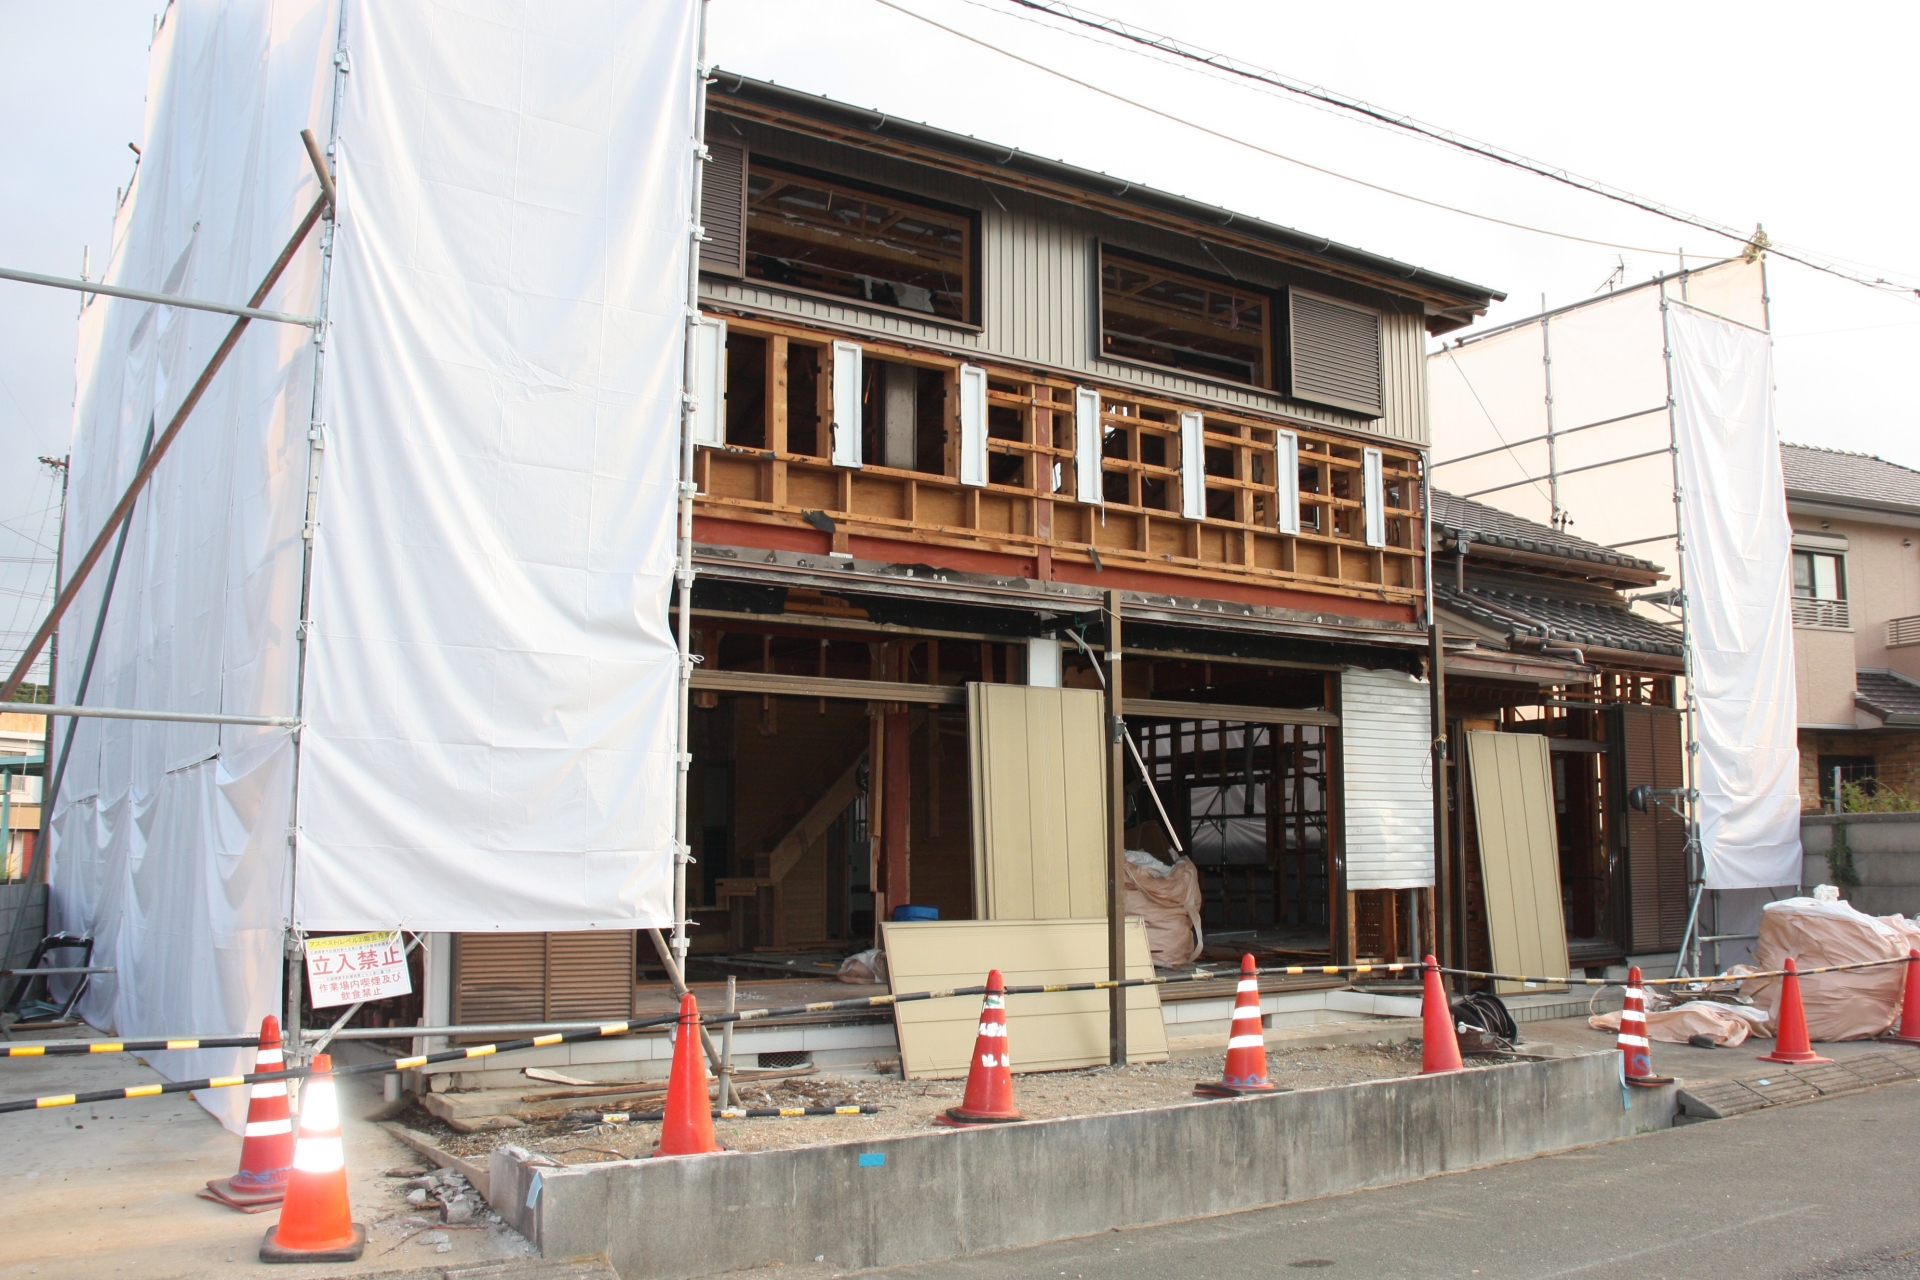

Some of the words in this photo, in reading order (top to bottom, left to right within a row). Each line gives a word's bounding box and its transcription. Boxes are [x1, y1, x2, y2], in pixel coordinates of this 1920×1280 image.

[312, 946, 403, 976] 立入禁止
[319, 972, 401, 993] 作業場内喫煙及び
[341, 987, 382, 1001] 飲食禁止
